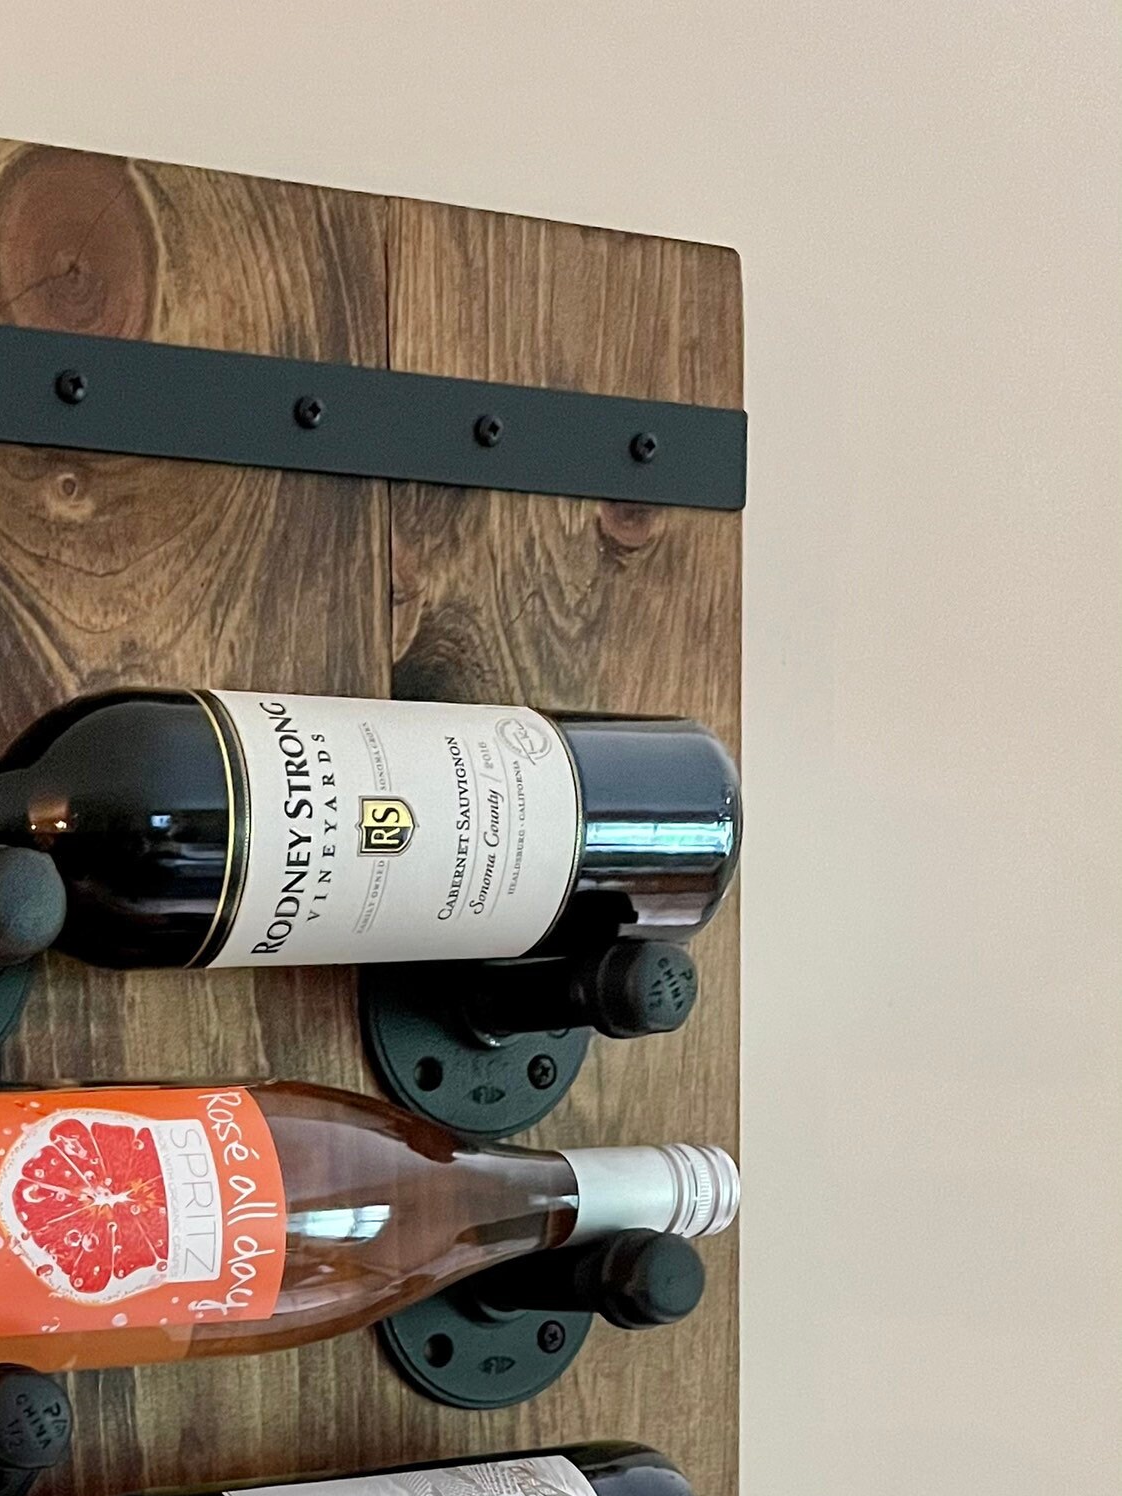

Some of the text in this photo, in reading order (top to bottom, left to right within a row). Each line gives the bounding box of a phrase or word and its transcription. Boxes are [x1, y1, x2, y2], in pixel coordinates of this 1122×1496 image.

[251, 702, 313, 954] RODNEY STRONG
[306, 733, 337, 922] VINEYARDS
[371, 806, 401, 846] RS
[437, 735, 470, 921] CABERNET SAUVIGNON
[469, 852, 496, 915] Sonoma
[484, 789, 505, 848] County
[507, 760, 526, 895] HEALDSBURG CALIFORNIA
[657, 957, 683, 1012] CHINA
[170, 1128, 217, 1275] SPRITZ
[188, 1091, 279, 1316] Rosé all day
[16, 1393, 52, 1450] CHINA
